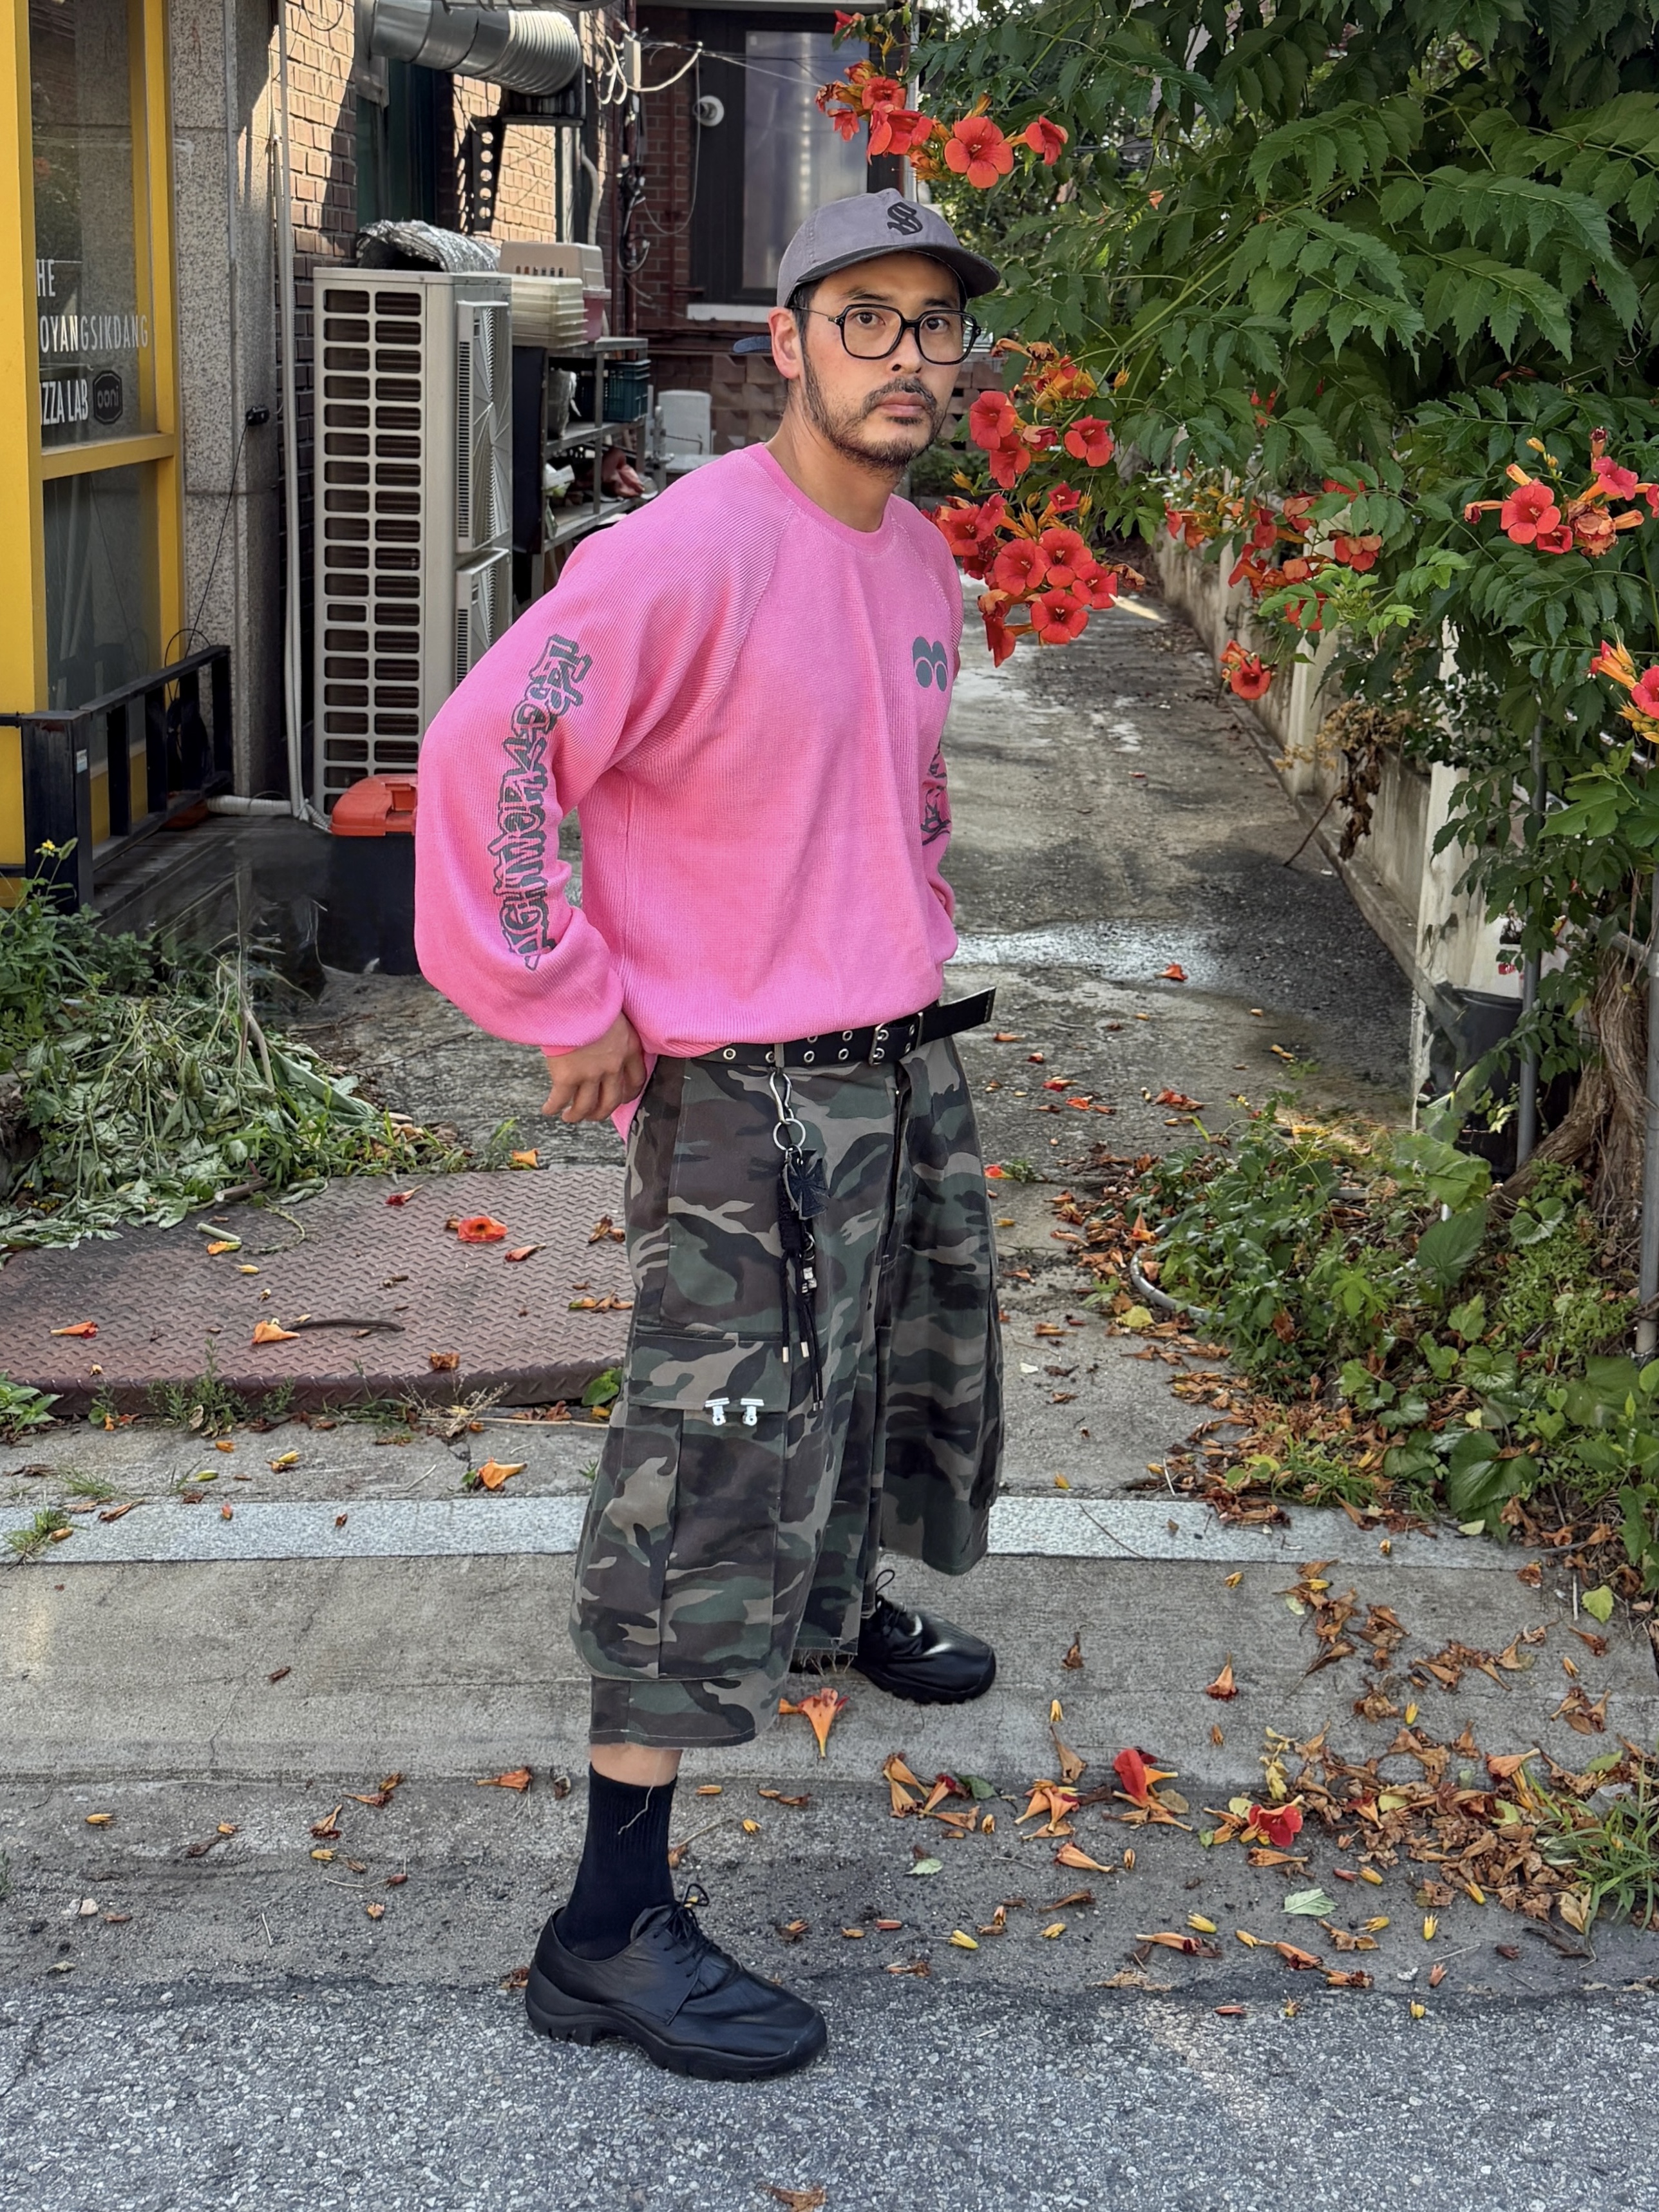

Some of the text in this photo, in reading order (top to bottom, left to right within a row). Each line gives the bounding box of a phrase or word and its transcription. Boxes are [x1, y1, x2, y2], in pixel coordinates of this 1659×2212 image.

[36, 258, 55, 296] HE
[39, 314, 148, 353] OYANGSIKDANG
[39, 378, 88, 425] IZZA LAB
[97, 385, 119, 408] ooni
